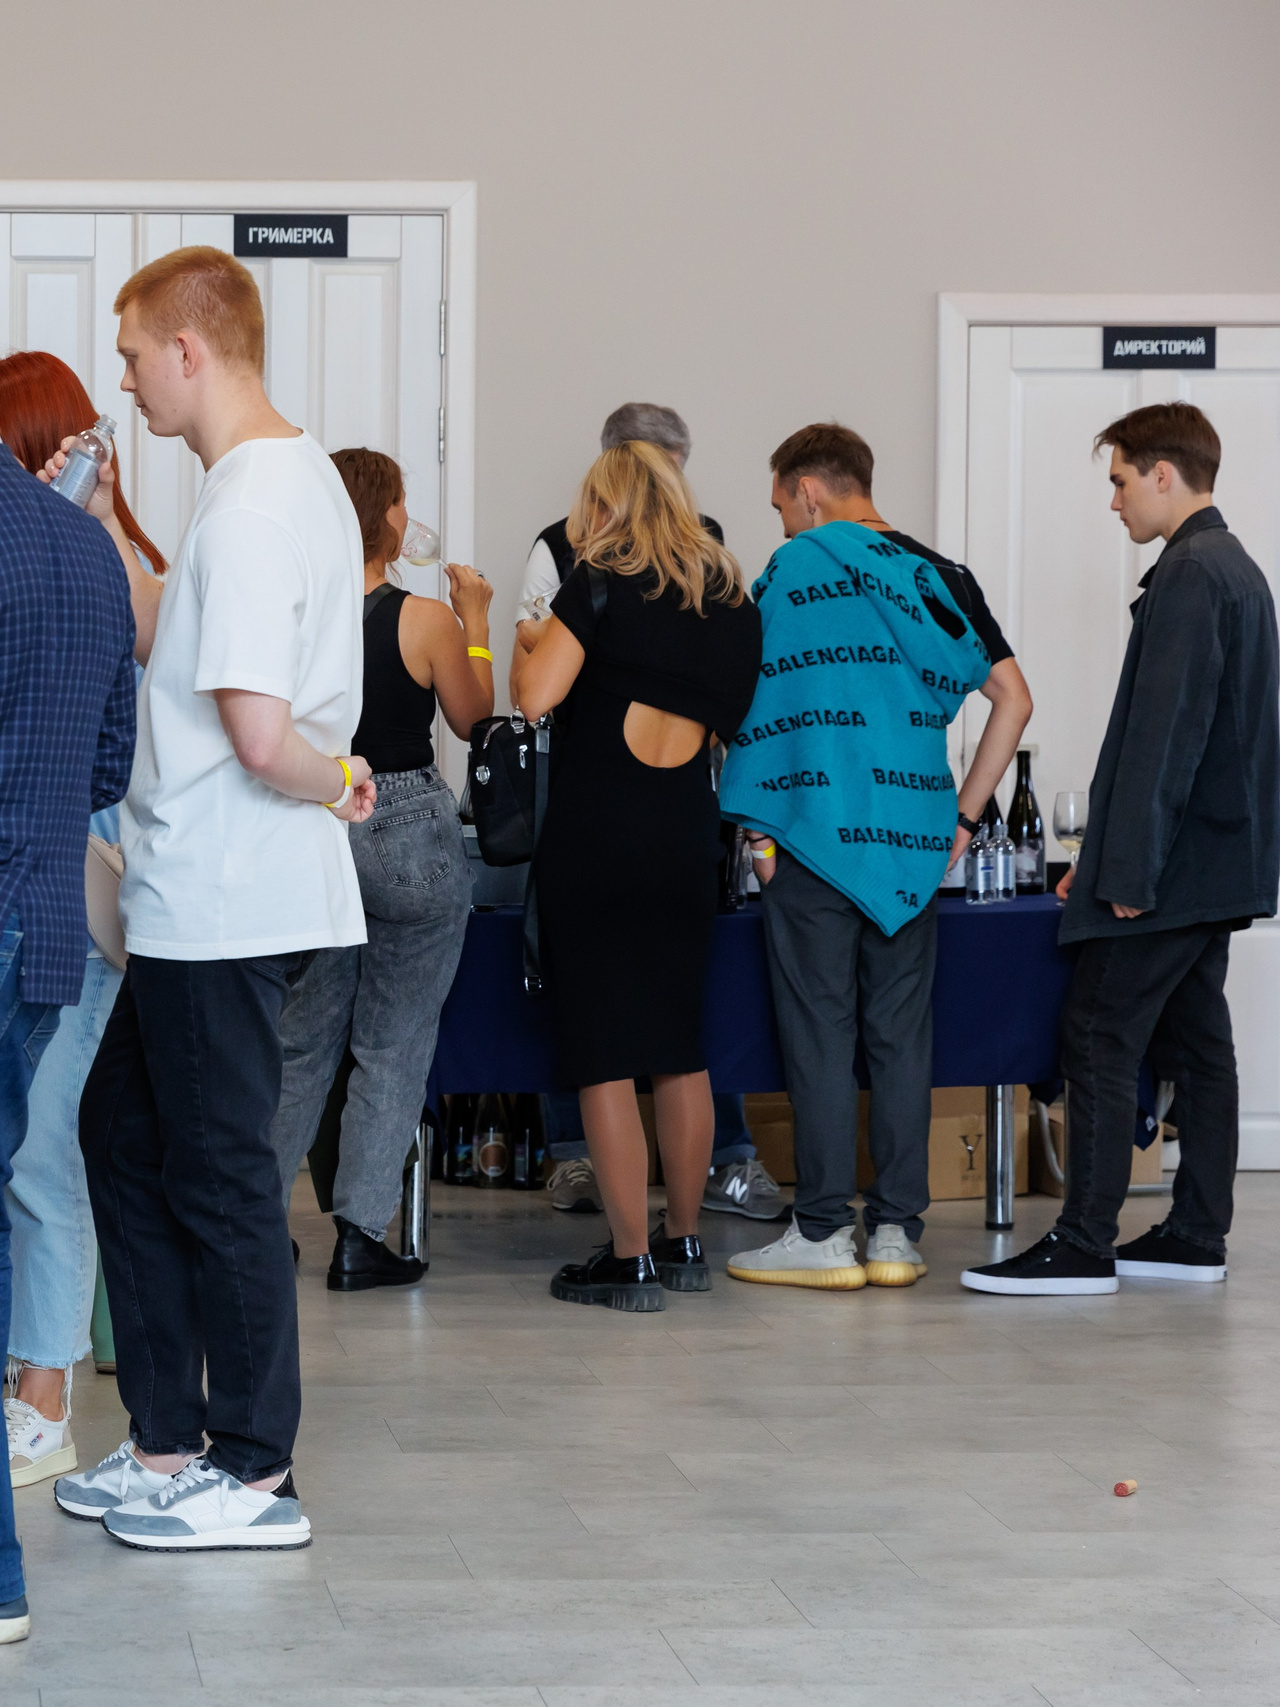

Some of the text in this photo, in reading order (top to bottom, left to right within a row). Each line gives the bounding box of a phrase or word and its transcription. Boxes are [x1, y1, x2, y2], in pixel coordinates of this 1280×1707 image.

[248, 227, 334, 244] ГРИМЕРКА
[1113, 336, 1206, 356] ДИРЕКТОРИЙ
[760, 645, 902, 679] BALENCIAGA
[733, 709, 868, 748] BALENCIAGA
